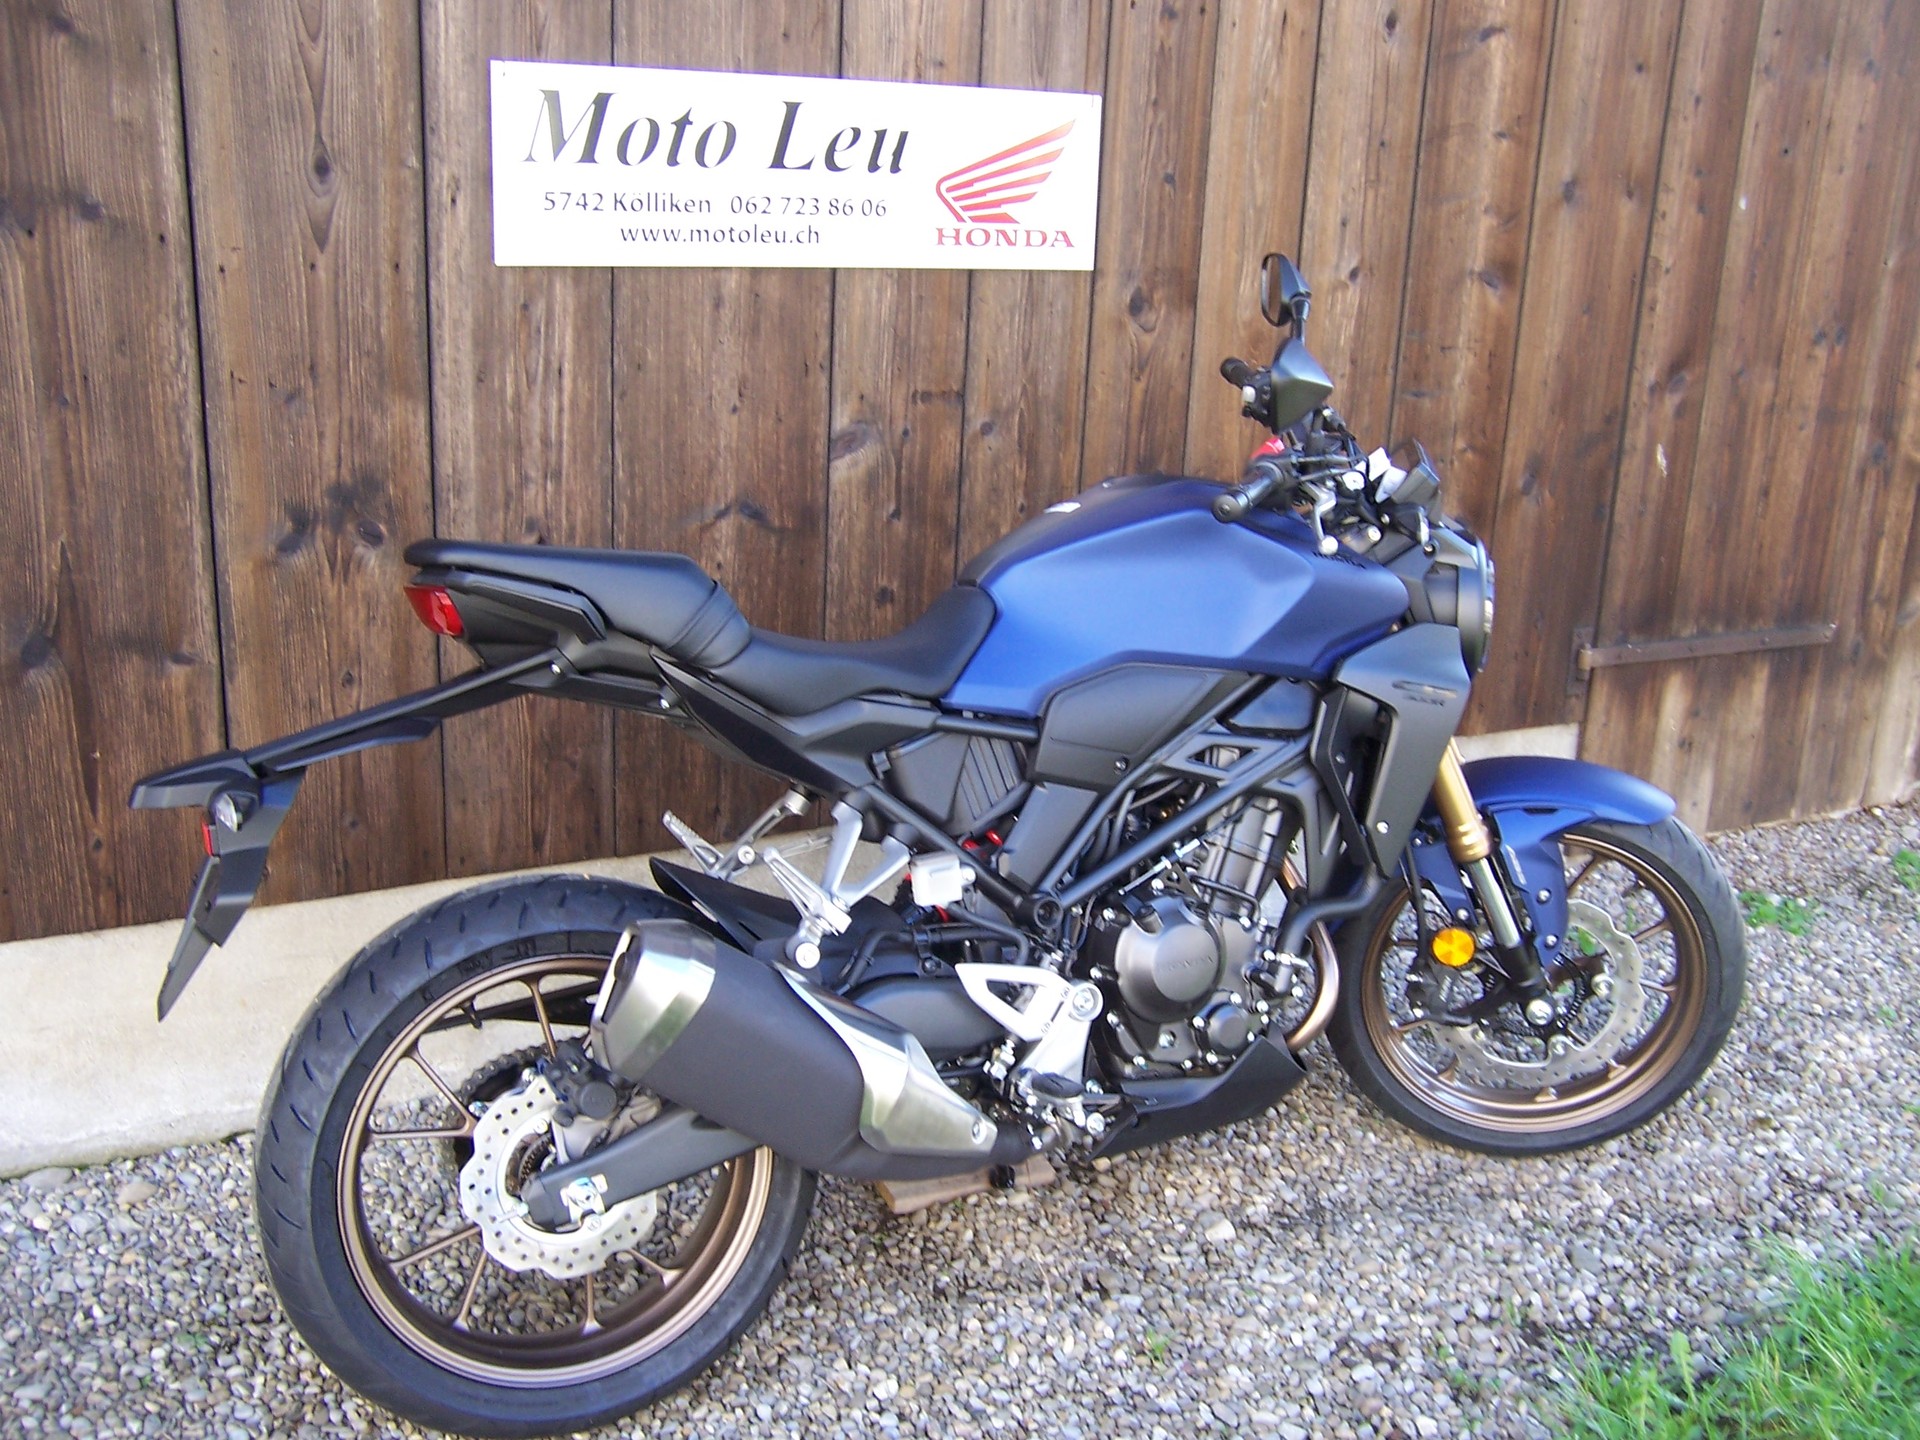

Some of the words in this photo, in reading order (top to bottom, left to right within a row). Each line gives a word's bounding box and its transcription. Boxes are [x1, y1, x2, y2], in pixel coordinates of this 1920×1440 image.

[523, 89, 737, 169] Moto
[767, 100, 910, 175] Leu
[544, 191, 604, 212] 5742
[613, 191, 711, 214] Kölliken
[730, 195, 772, 215] 062
[780, 196, 820, 216] 723
[828, 197, 854, 217] 86
[861, 198, 887, 217] 06
[620, 223, 820, 245] www.motoleu.ch
[935, 227, 1075, 248] HONDA
